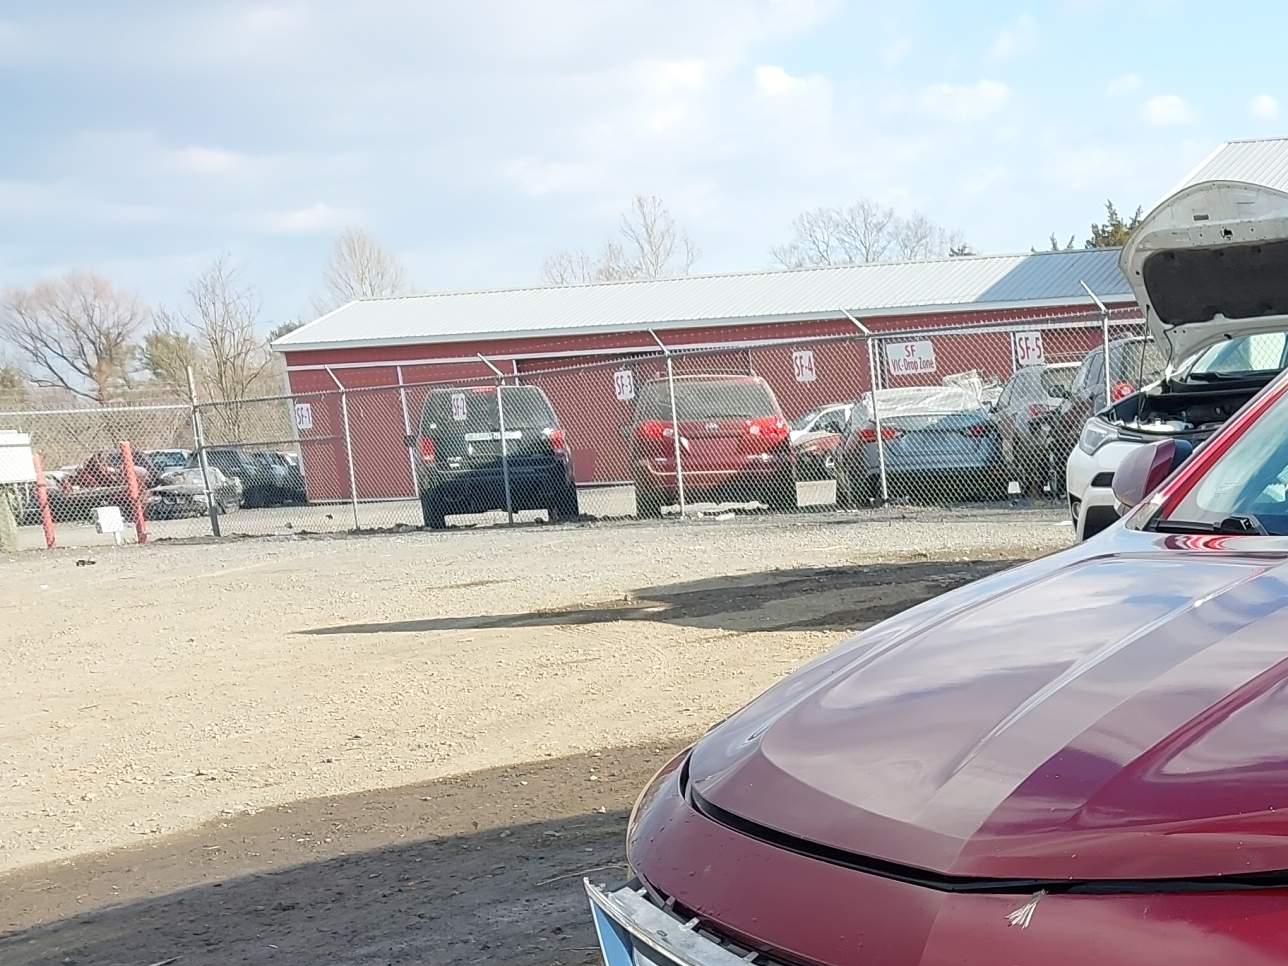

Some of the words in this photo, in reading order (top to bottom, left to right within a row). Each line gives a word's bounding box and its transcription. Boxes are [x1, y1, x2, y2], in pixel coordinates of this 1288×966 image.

[904, 344, 916, 358] SF
[1018, 336, 1042, 360] SF-5
[794, 354, 815, 378] SF-4
[919, 357, 934, 371] Zone
[615, 375, 634, 396] SF-3
[296, 406, 312, 425] SF-1
